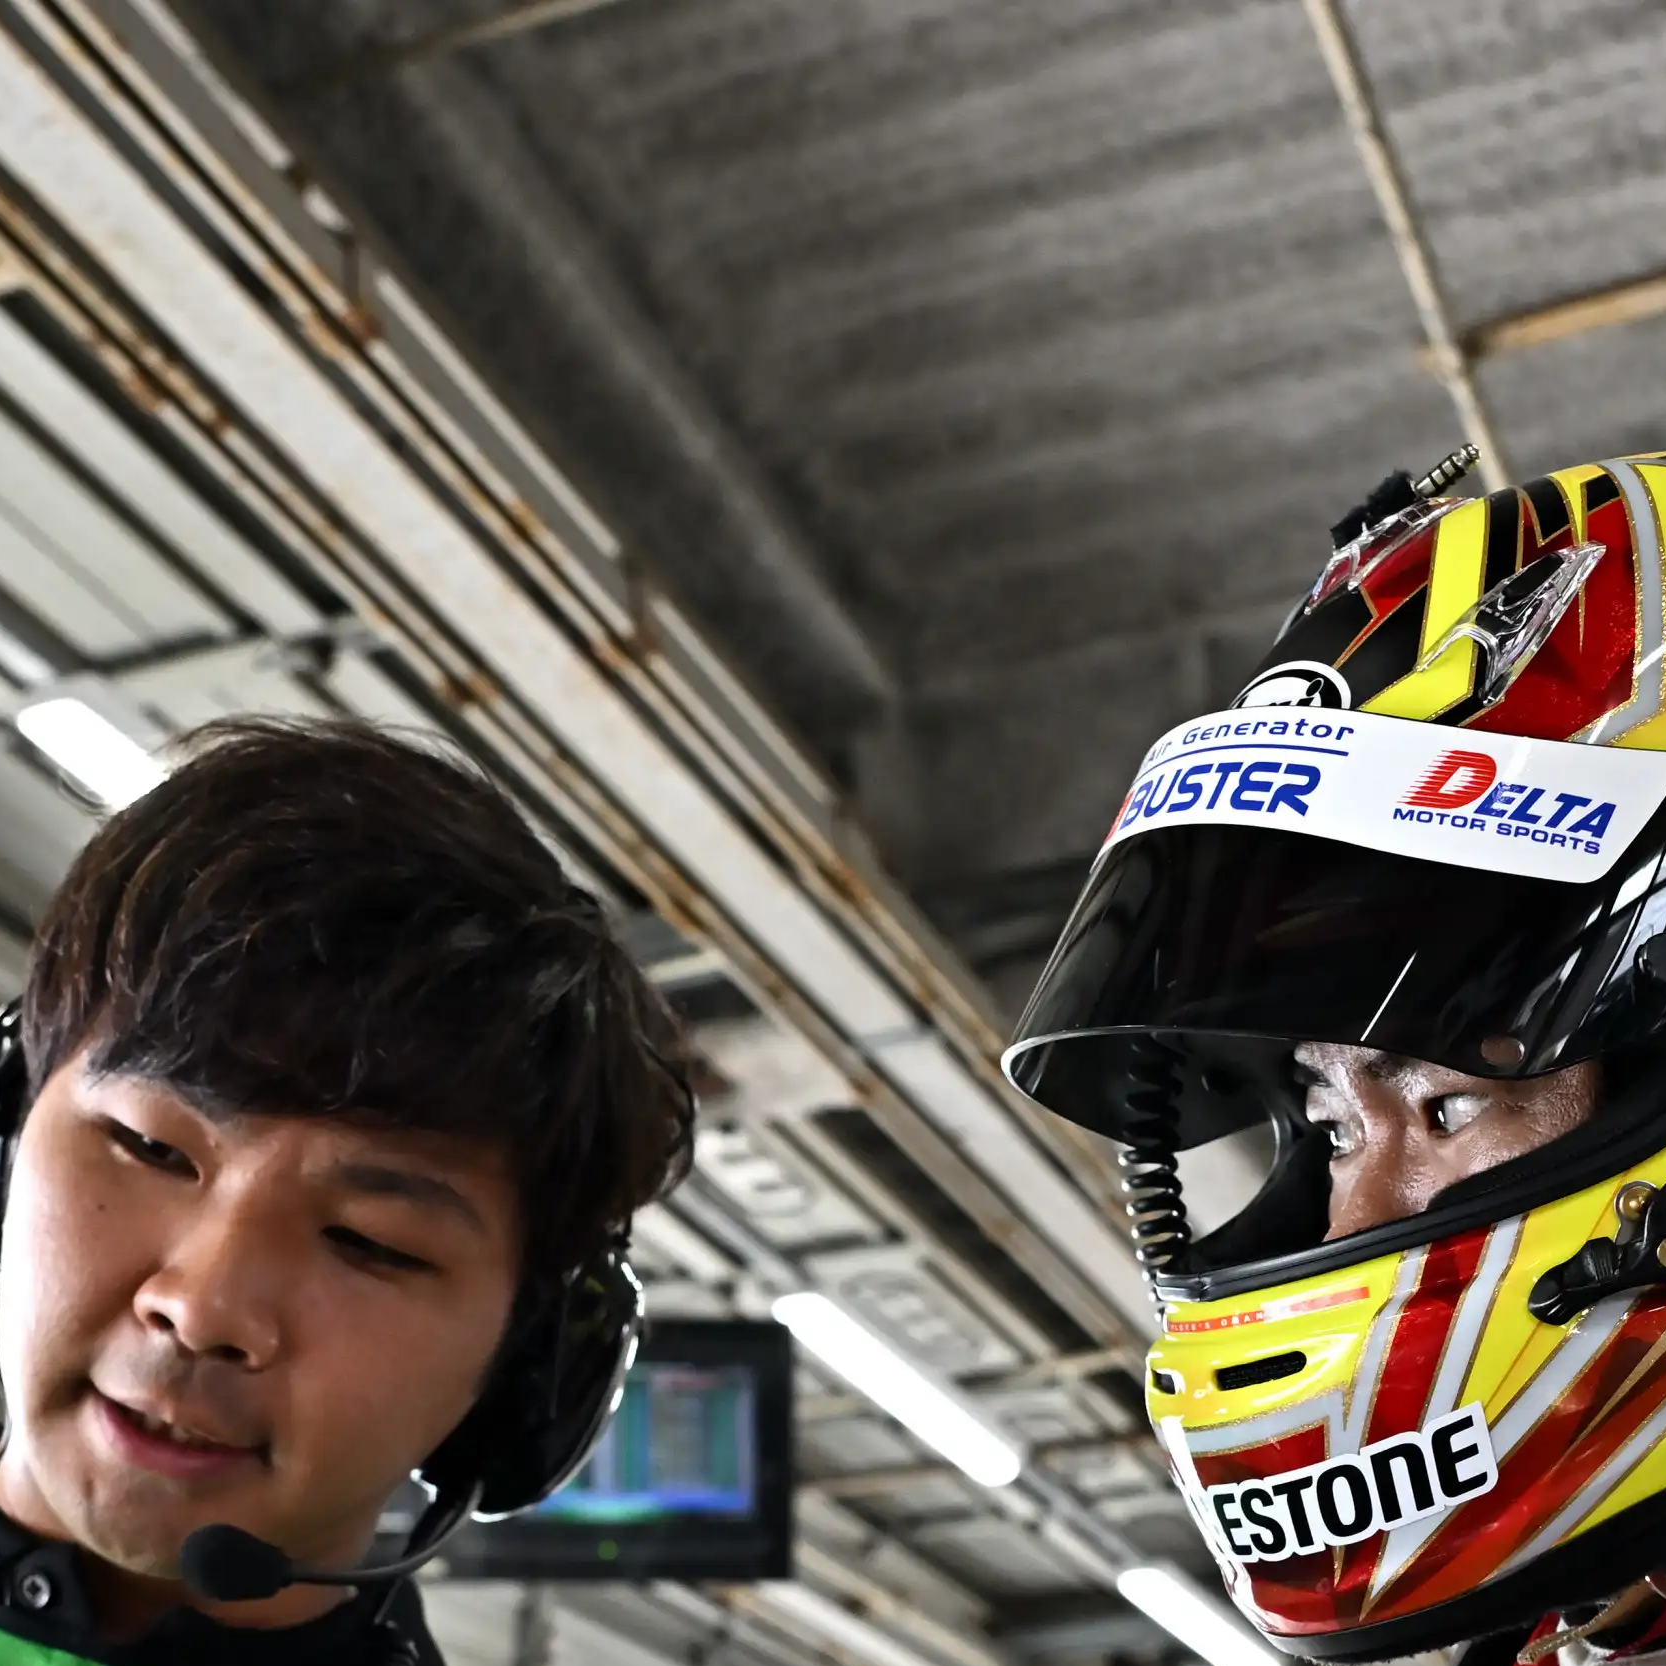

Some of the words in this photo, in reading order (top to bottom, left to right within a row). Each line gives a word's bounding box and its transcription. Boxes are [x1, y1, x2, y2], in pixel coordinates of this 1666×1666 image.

[1182, 718, 1355, 745] Generator
[1119, 761, 1321, 830] BUSTER
[1397, 750, 1617, 840] DELTA
[1393, 808, 1487, 832] MOTOR
[1496, 822, 1602, 855] SPORTS
